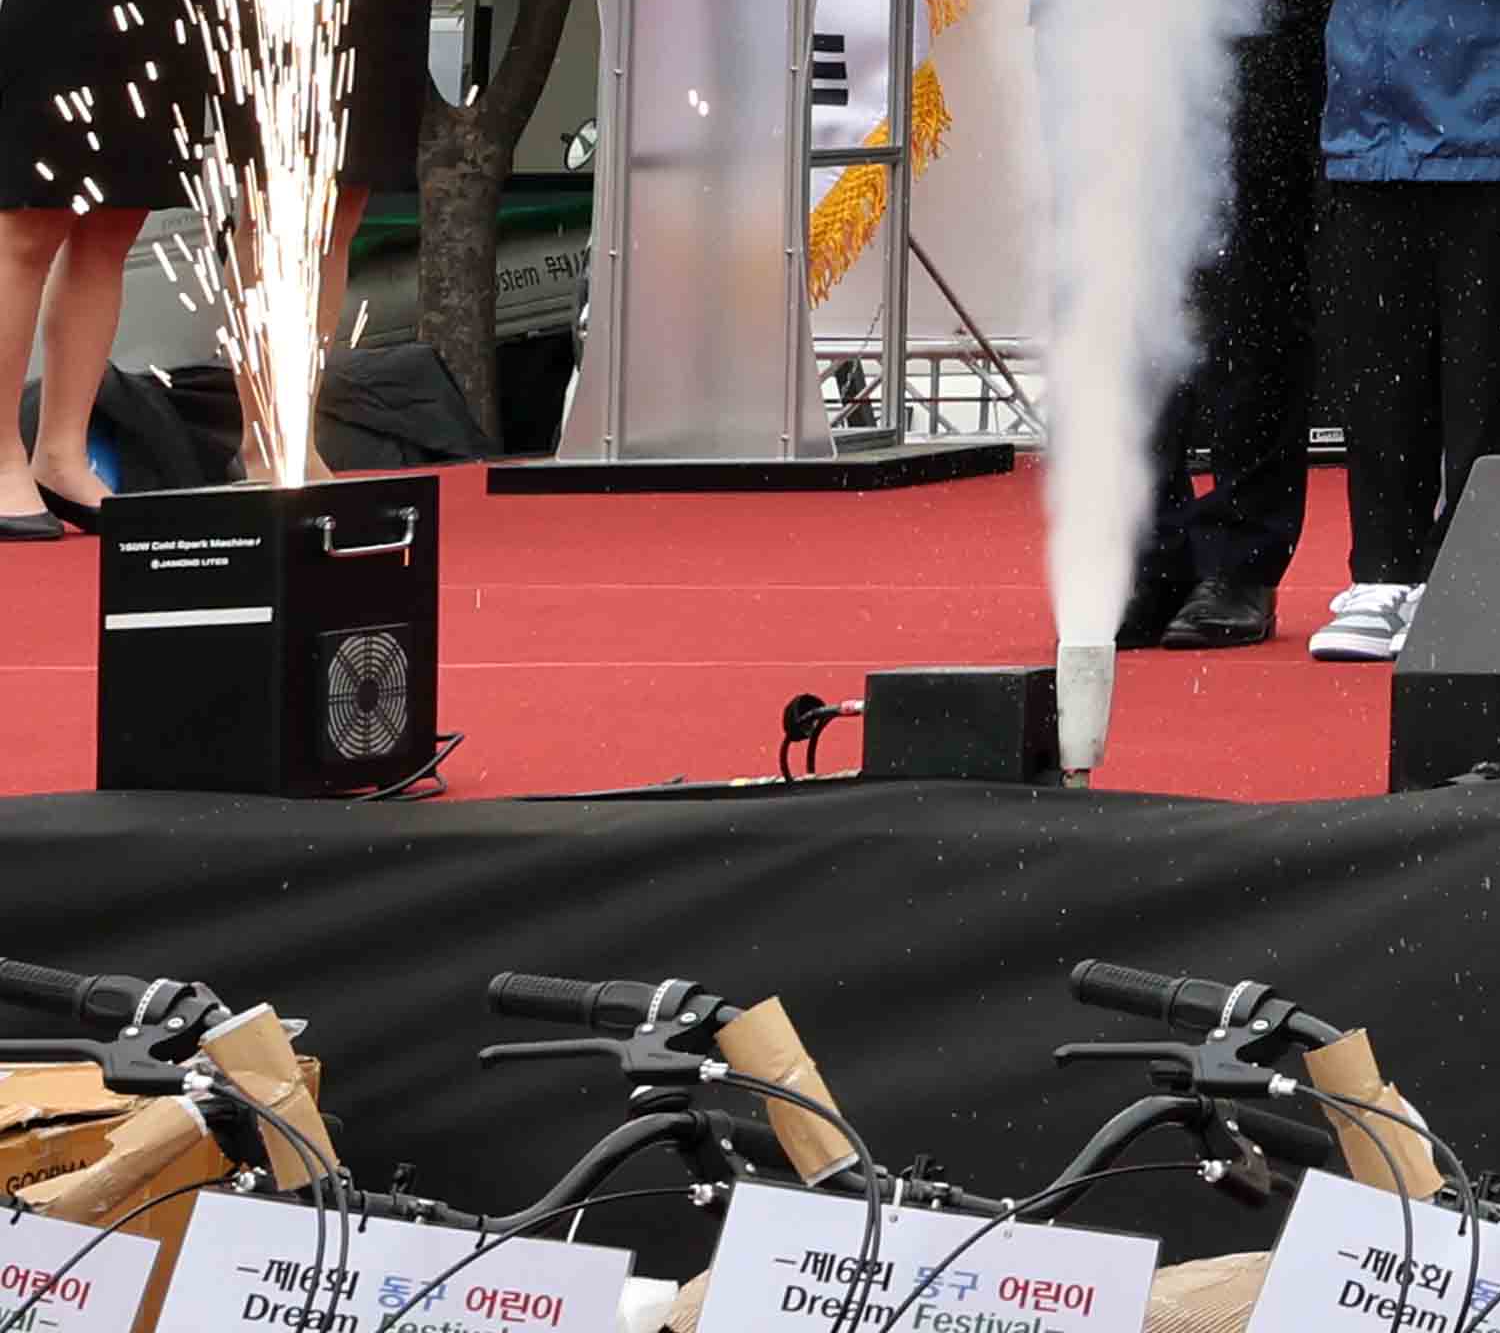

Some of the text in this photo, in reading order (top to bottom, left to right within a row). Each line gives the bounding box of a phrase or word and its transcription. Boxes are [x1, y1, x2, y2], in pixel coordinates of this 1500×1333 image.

[0, 1264, 91, 1310] 어린이
[378, 1274, 448, 1312] 동구
[464, 1284, 564, 1327] 어린이
[913, 1266, 980, 1301] 동구
[998, 1275, 1095, 1317] 어린이
[1338, 1280, 1447, 1332] Dream
